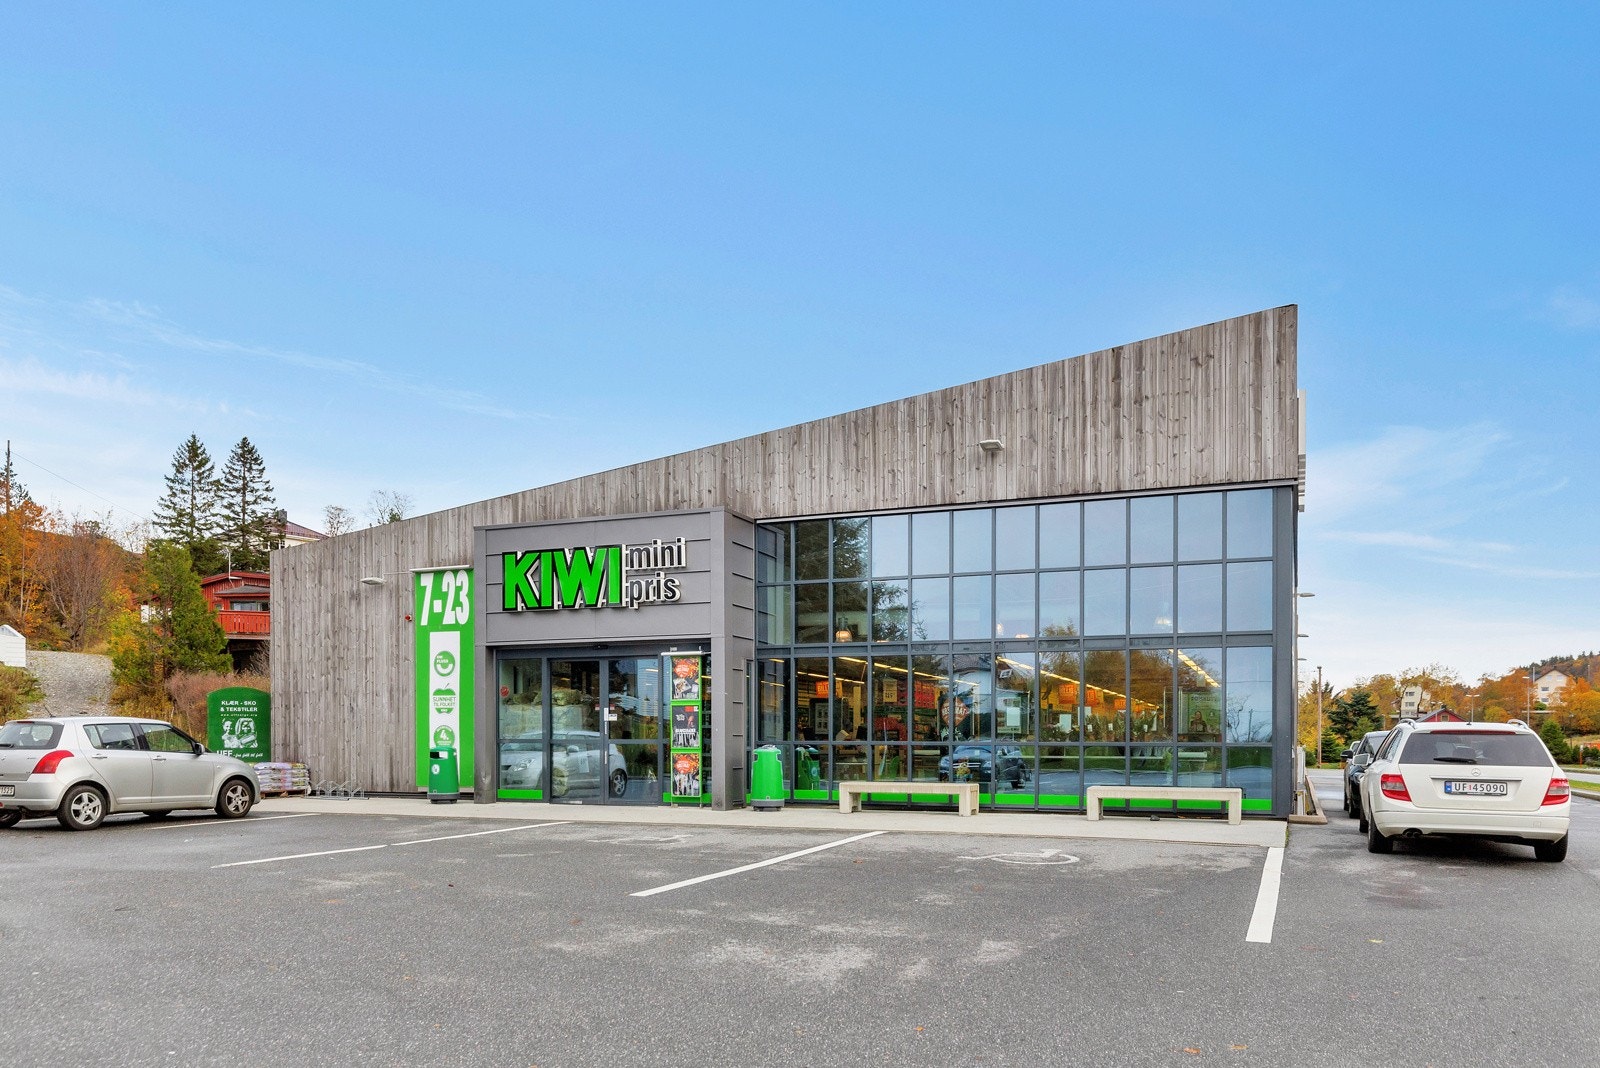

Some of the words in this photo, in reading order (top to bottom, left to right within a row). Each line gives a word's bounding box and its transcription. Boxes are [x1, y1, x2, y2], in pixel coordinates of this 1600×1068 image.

[630, 537, 686, 569] mini
[502, 543, 626, 612] KIWI
[630, 571, 681, 610] pris
[420, 569, 470, 627] 7-23
[1454, 782, 1467, 792] UF
[1472, 783, 1505, 792] 45090
